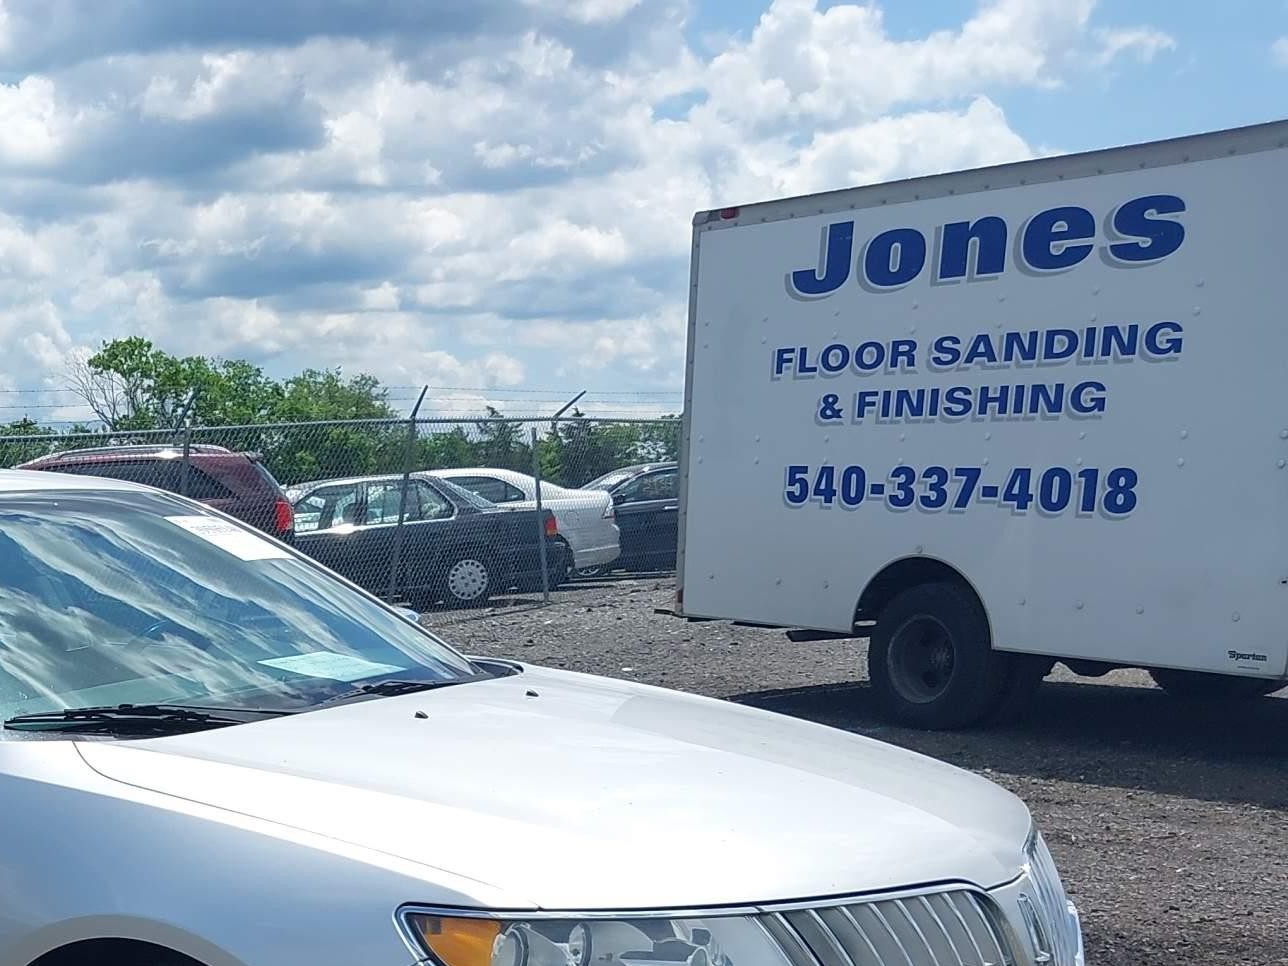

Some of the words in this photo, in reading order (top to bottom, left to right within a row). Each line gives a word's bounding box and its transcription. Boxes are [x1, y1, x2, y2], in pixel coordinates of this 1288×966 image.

[791, 194, 1187, 296] Jones
[774, 339, 918, 376] FLOOR
[932, 321, 1184, 367] SANDING
[819, 393, 844, 420] &
[856, 381, 1107, 419] FINISHING
[786, 465, 1139, 515] 540-337-4018
